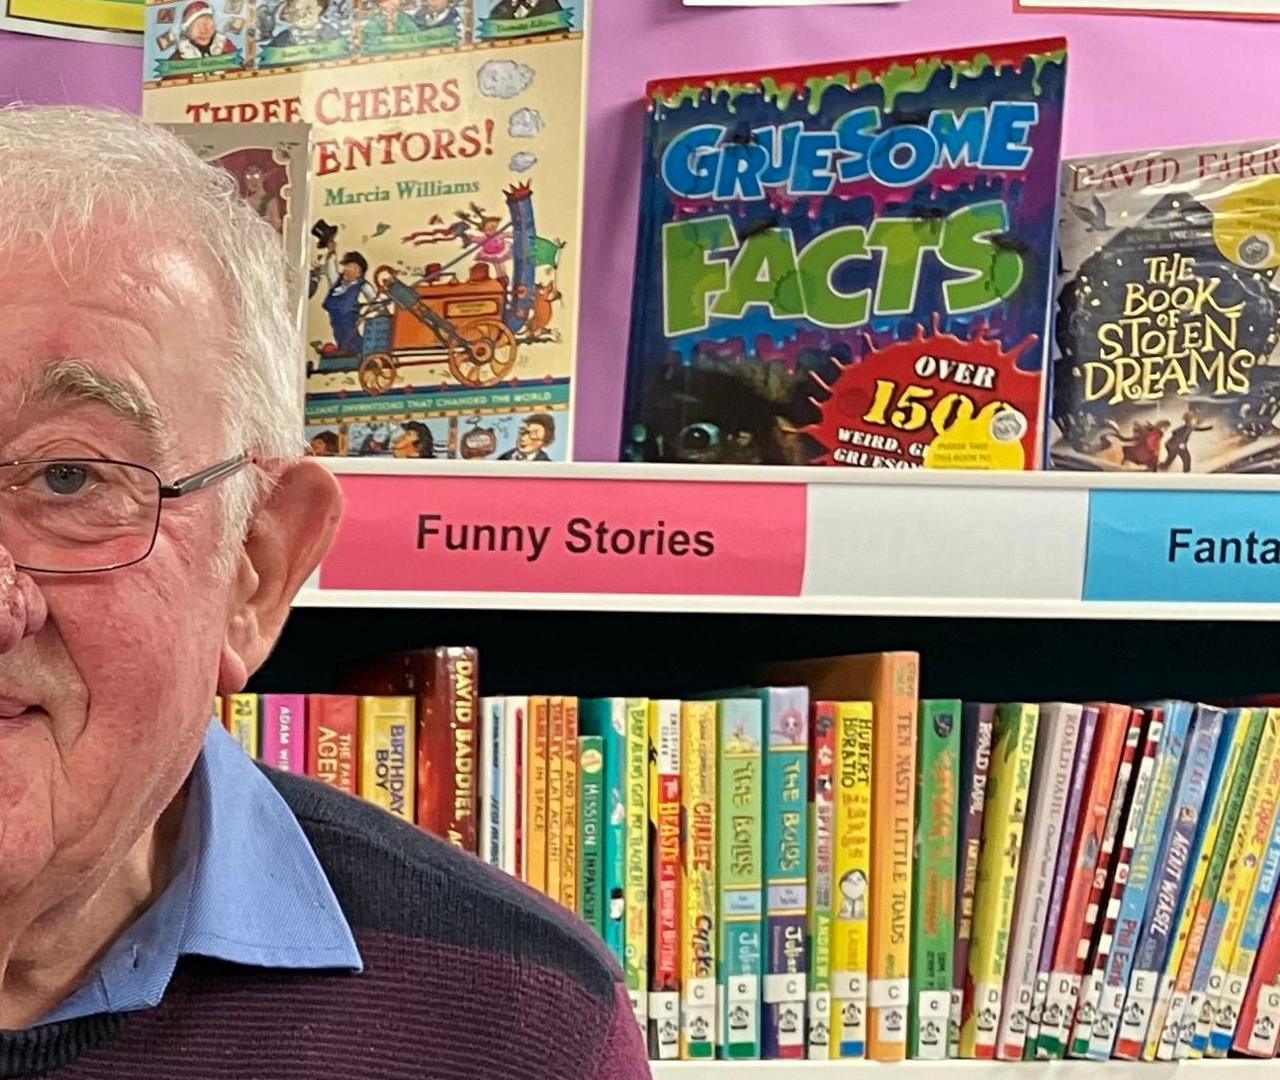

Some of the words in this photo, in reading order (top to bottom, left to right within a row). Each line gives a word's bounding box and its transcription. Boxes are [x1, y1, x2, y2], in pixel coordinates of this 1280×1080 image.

[314, 79, 461, 126] CHEERS
[315, 118, 496, 176] ENTORS!
[661, 101, 1039, 202] GRUESOME
[324, 187, 390, 207] Marcia
[396, 179, 480, 200] Williams
[1071, 157, 1181, 193] DAVID
[662, 199, 1025, 339] FACTS
[1143, 253, 1195, 287] THE
[1123, 277, 1246, 316] BOOK
[1156, 309, 1181, 329] OF
[1098, 311, 1242, 360] STOLEN
[914, 356, 997, 389] OVER
[1083, 349, 1255, 406] DREAMS
[416, 513, 550, 561] Funny
[565, 516, 717, 560] Stories
[454, 660, 473, 723] DAVID
[841, 717, 858, 788] HORATIO
[857, 718, 872, 783] HUBERT
[896, 712, 912, 747] TEN
[375, 749, 389, 791] BOY
[390, 724, 405, 815] BIRTHDAY
[454, 728, 472, 821] BADDIEL
[895, 755, 910, 806] NASTY
[892, 817, 908, 882] LITTLE
[891, 893, 907, 944] TOADS
